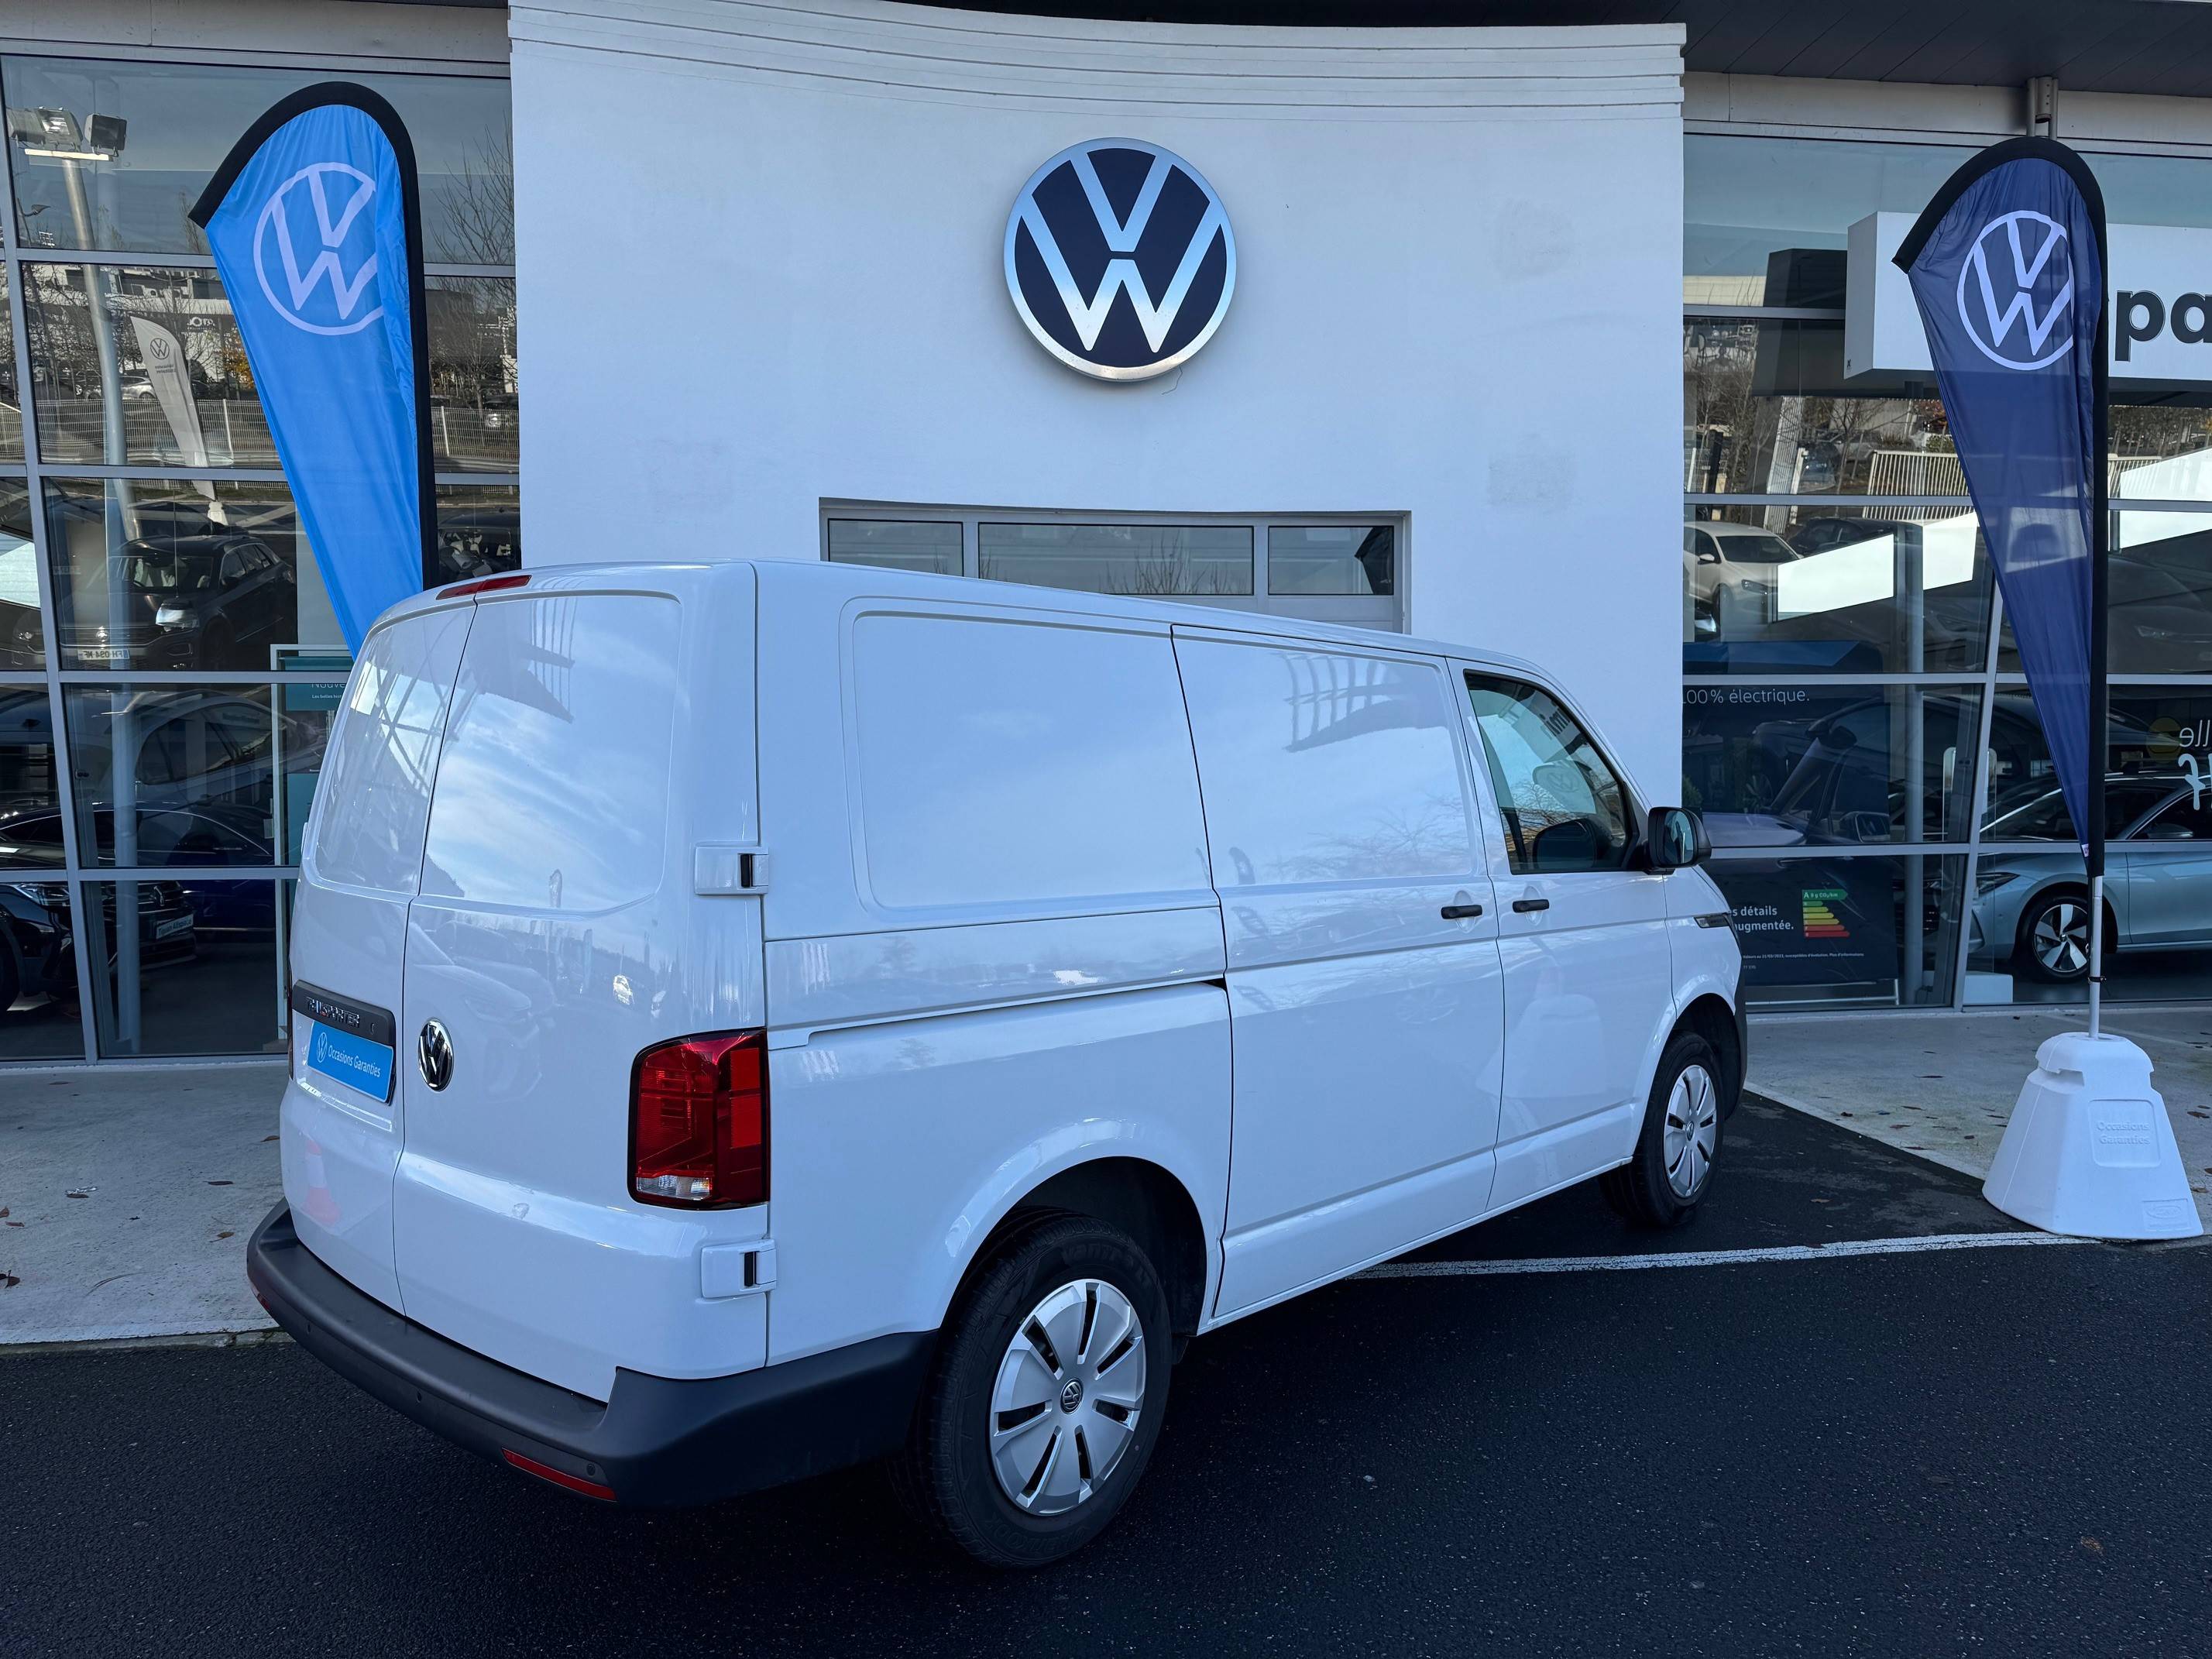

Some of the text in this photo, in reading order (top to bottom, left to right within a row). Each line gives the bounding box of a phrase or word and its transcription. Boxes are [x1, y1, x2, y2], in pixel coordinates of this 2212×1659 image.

[1729, 689, 1810, 706] électrique.
[1740, 905, 1778, 916] détails
[328, 1046, 353, 1066] Occasions
[353, 1056, 381, 1077] Garanties
